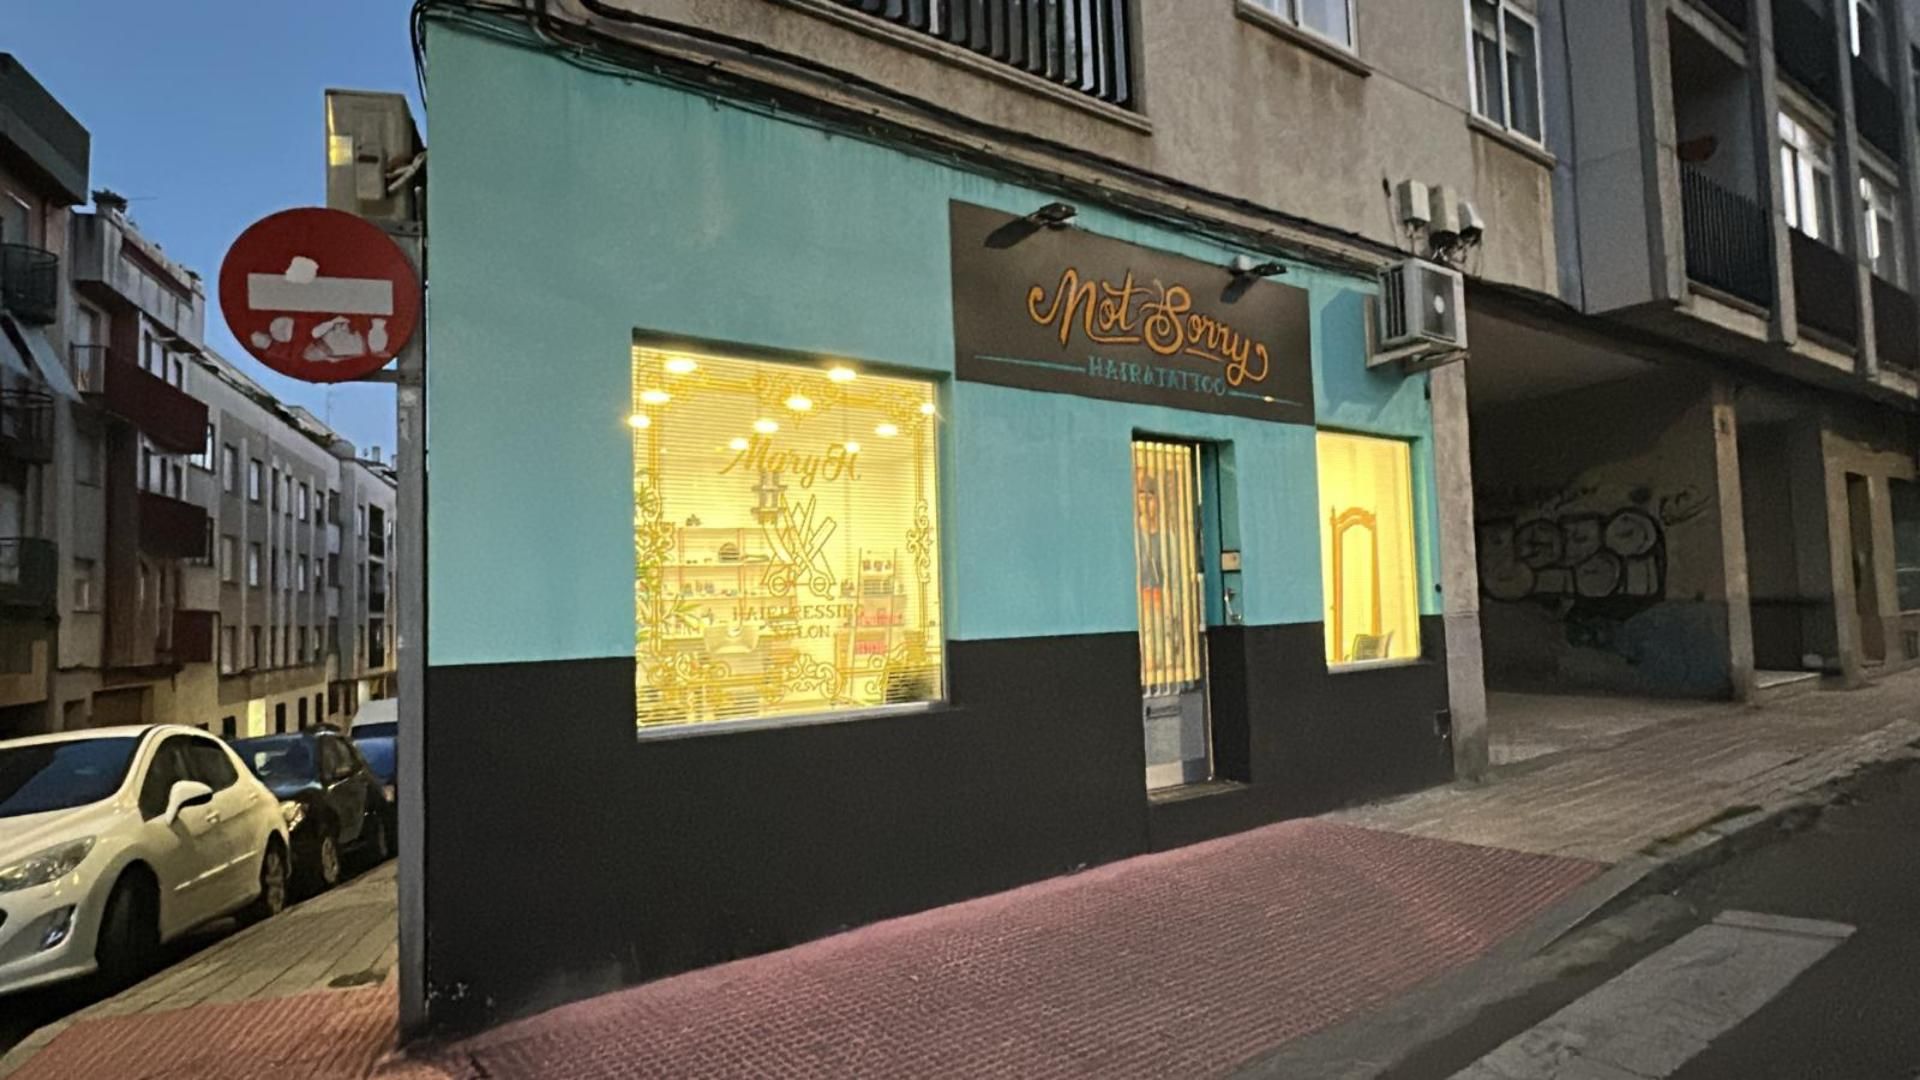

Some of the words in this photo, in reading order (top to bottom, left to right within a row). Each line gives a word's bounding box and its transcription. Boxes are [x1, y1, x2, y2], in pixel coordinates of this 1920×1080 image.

[1028, 267, 1150, 348] Not
[1141, 279, 1269, 386] Sorry
[718, 432, 819, 489] Mary
[774, 624, 831, 640] LON
